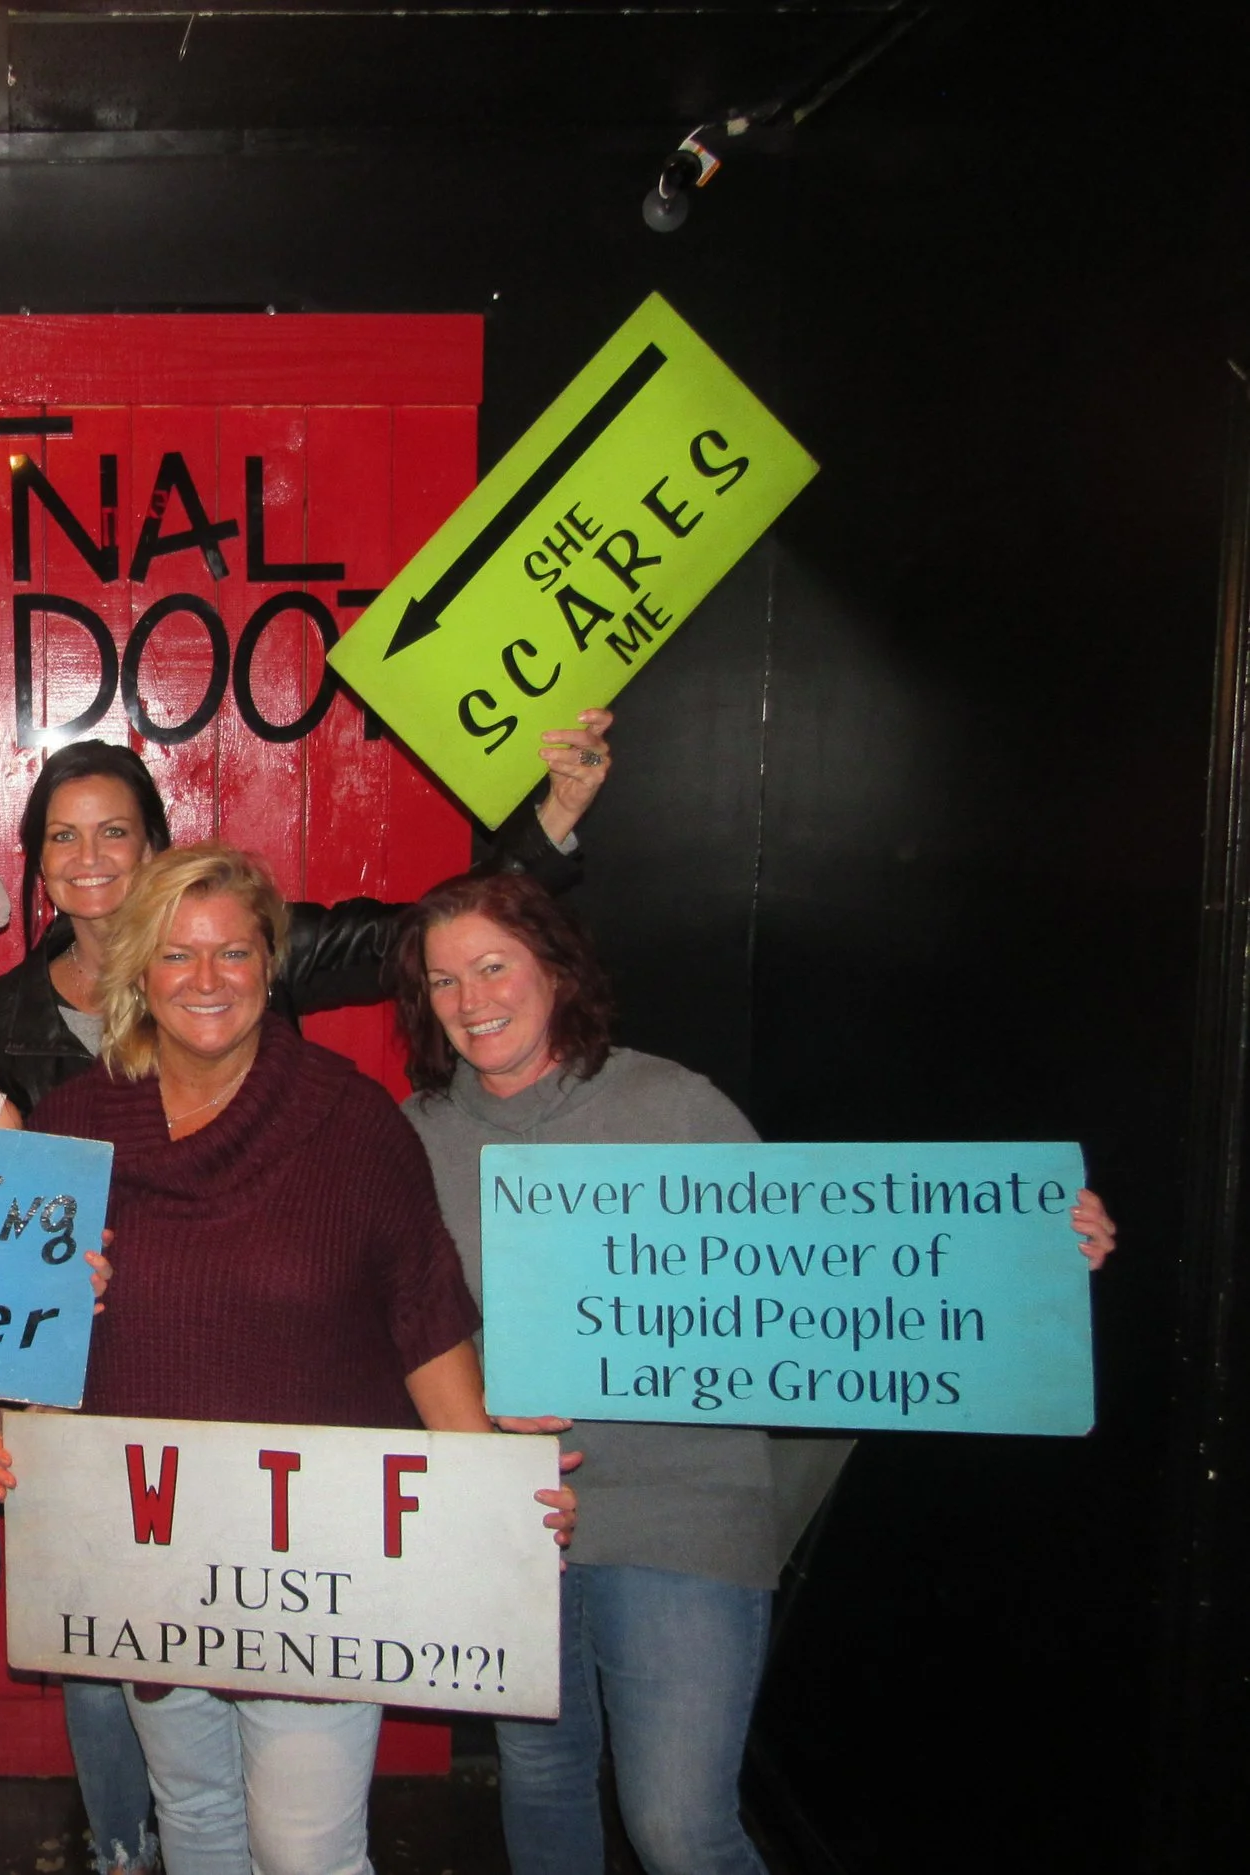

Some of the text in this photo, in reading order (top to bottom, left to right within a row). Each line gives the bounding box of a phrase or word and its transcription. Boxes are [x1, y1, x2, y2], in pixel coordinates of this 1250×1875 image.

[523, 501, 603, 592] SHE
[457, 430, 749, 755] SCARES
[604, 592, 672, 666] ME
[494, 1171, 1066, 1216] Never Underestimate
[603, 1233, 951, 1278] the Power of
[576, 1294, 985, 1351] Stupid People in
[600, 1357, 962, 1416] Large Groups
[200, 1563, 352, 1616] JUST
[58, 1612, 506, 1693] HAPPENED?!?!
